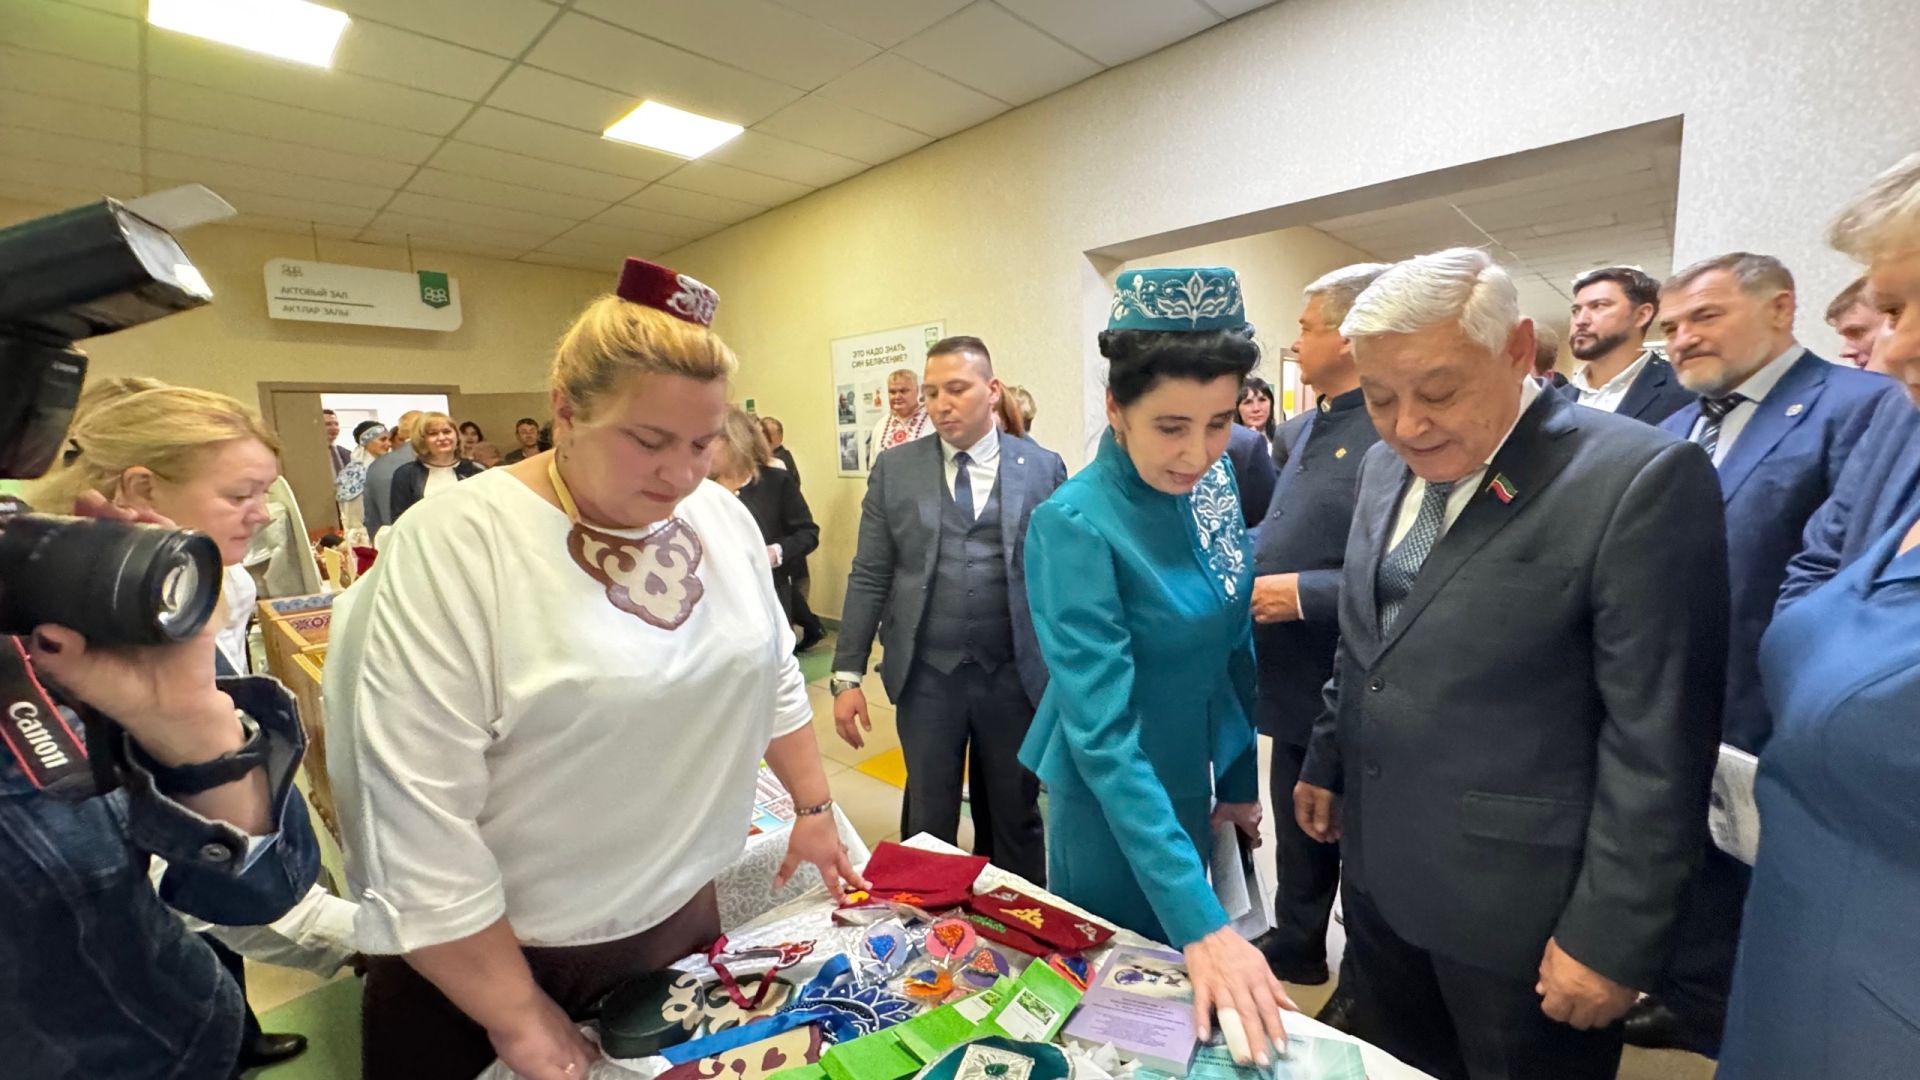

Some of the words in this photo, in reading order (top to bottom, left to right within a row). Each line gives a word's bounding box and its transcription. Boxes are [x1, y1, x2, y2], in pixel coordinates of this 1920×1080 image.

[281, 287, 327, 297] АКТОВЫЙ
[330, 290, 348, 299] ЗАЛ
[852, 350, 864, 359] ЭТО
[866, 347, 883, 356] НАДО
[884, 344, 905, 354] ЗНАТЬ
[9, 701, 69, 769] Canon
